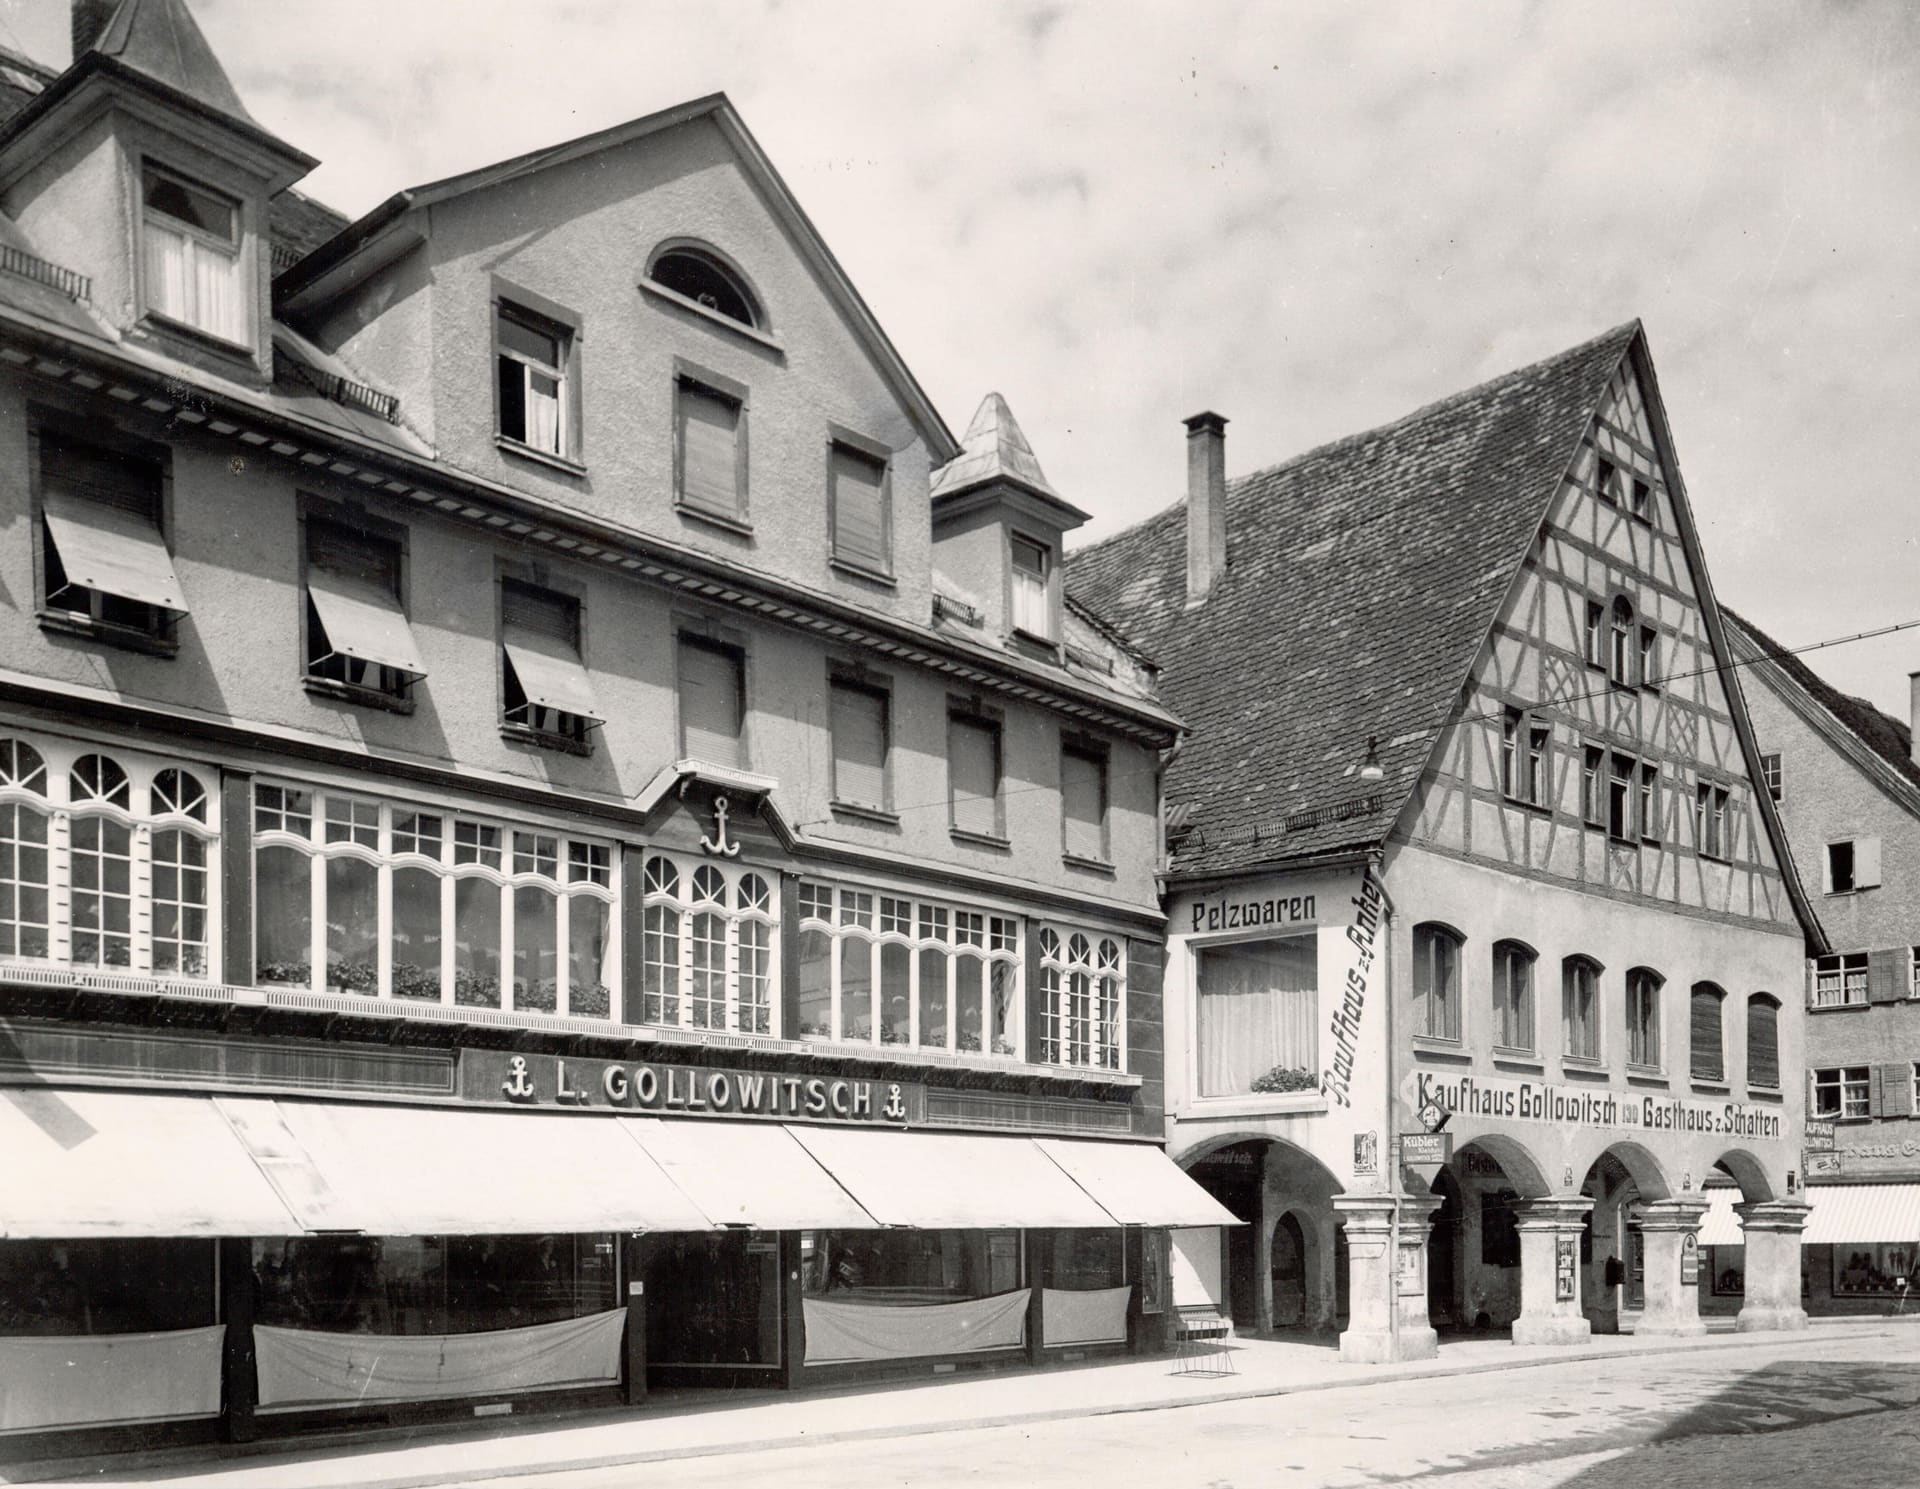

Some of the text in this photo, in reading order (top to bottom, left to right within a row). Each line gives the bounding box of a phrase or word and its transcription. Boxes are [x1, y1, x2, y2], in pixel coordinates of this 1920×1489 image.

[1192, 895, 1316, 932] Pelzwaren
[1321, 967, 1367, 1108] Kaufhaus
[557, 1060, 871, 1114] L. GOLLOWITSCH
[1417, 1072, 1515, 1116] Kaufhaus
[1520, 1083, 1617, 1125] Gollowitsch
[1643, 1096, 1713, 1133] Gasthaus
[1724, 1103, 1779, 1137] Schatten
[1403, 1135, 1440, 1148] Kübler
[1806, 1121, 1833, 1135] AUFHAUS
